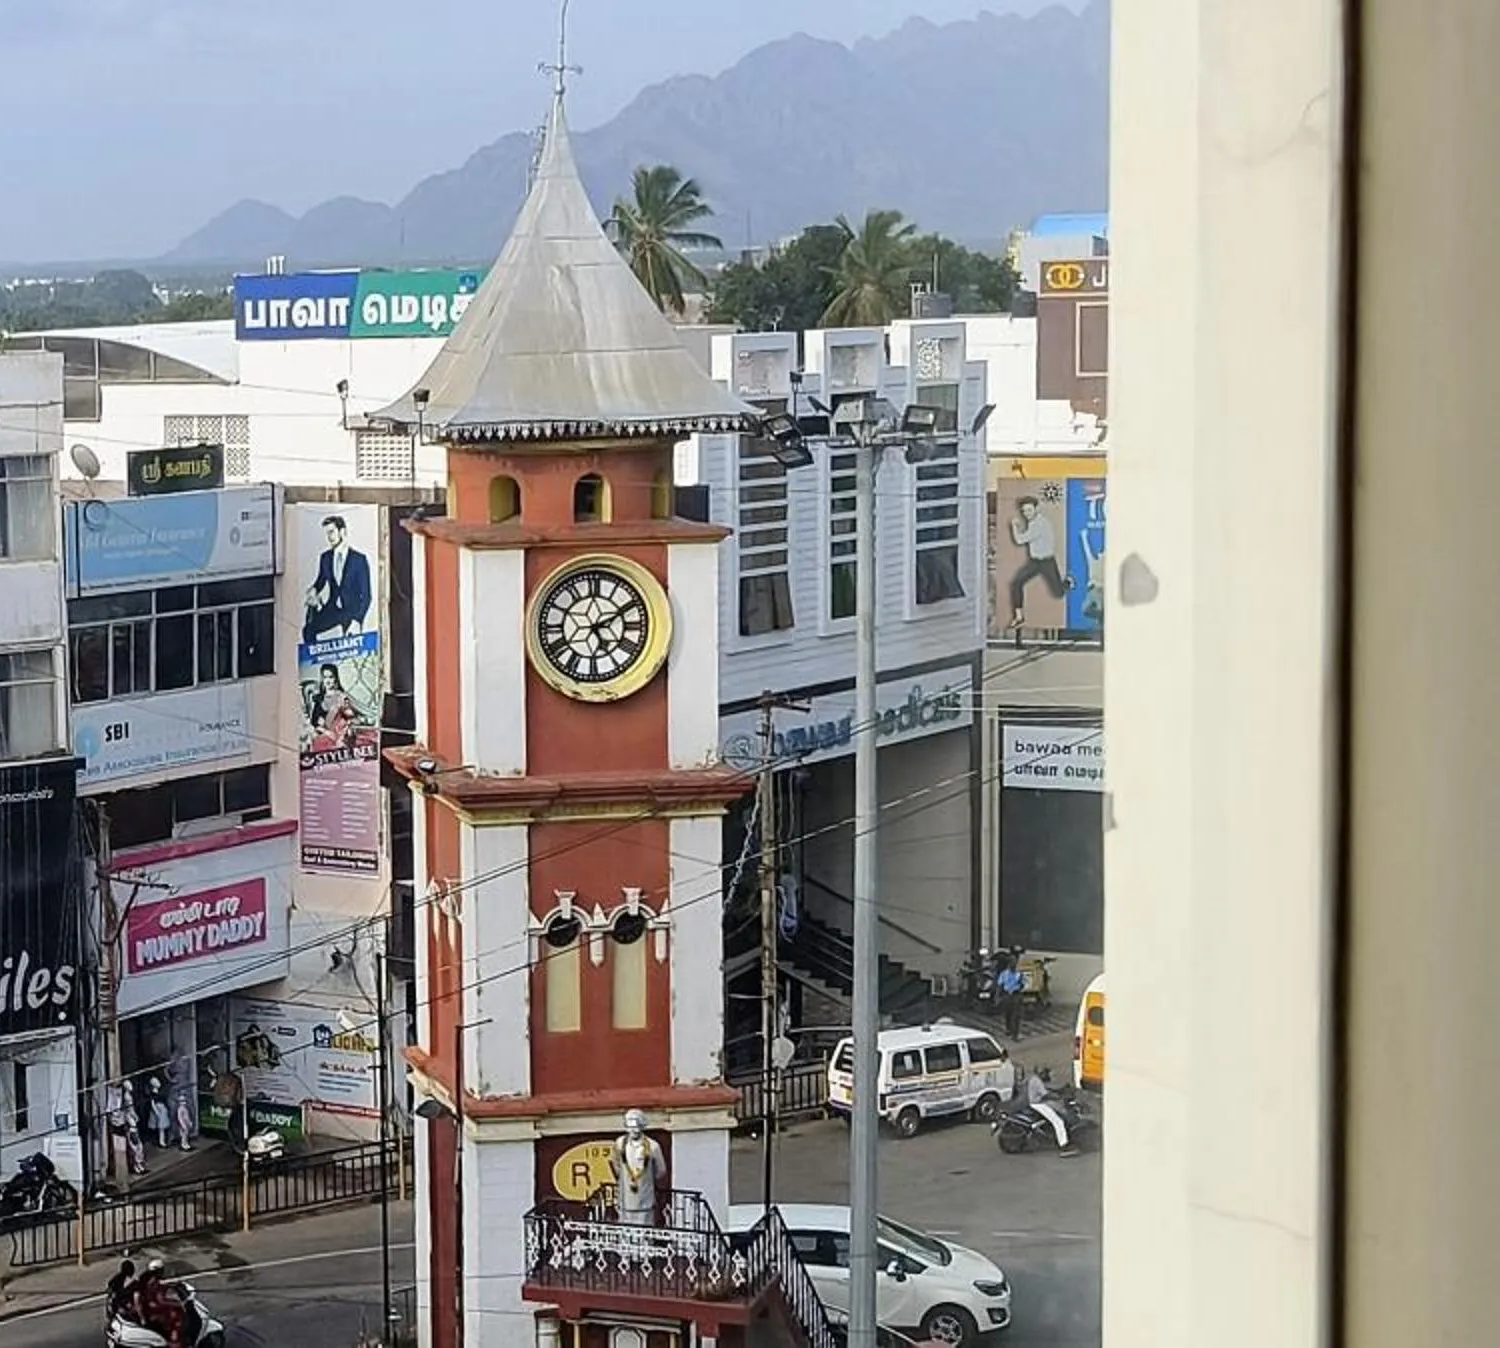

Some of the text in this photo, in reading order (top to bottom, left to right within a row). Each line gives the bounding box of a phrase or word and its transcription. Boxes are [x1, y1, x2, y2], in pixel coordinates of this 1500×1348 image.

[244, 298, 349, 329] பாவா
[105, 722, 129, 742] SBI
[136, 911, 265, 966] MUMMY DADDY
[571, 1162, 591, 1187] R
